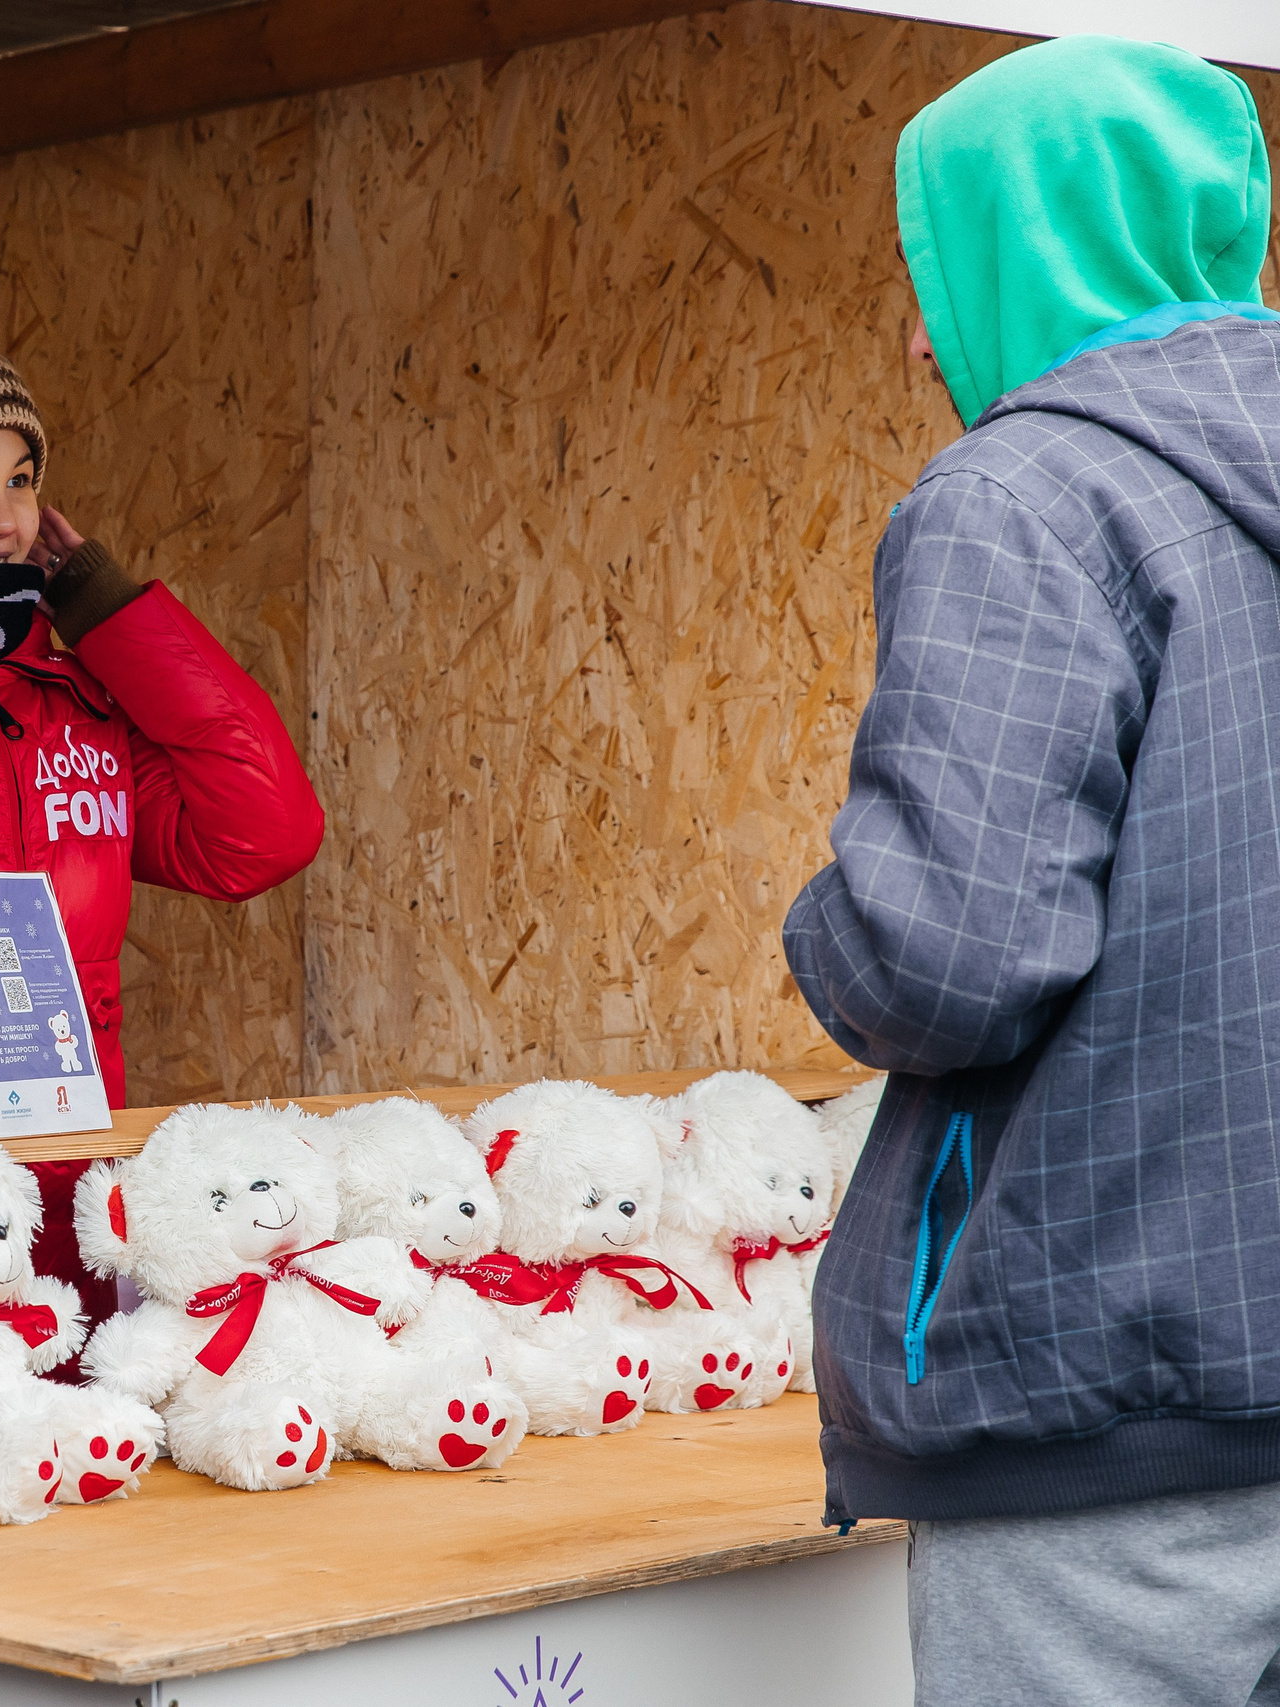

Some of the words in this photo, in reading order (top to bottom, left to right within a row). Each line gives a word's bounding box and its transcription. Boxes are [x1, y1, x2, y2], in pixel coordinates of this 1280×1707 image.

[35, 724, 118, 790] Добро
[44, 790, 128, 841] FON
[1, 1025, 24, 1034] ДОБРОЕ
[24, 1024, 40, 1032] ДЕЛО
[15, 1045, 40, 1053] ПРОСТО
[5, 1055, 27, 1064] ДОБРО!
